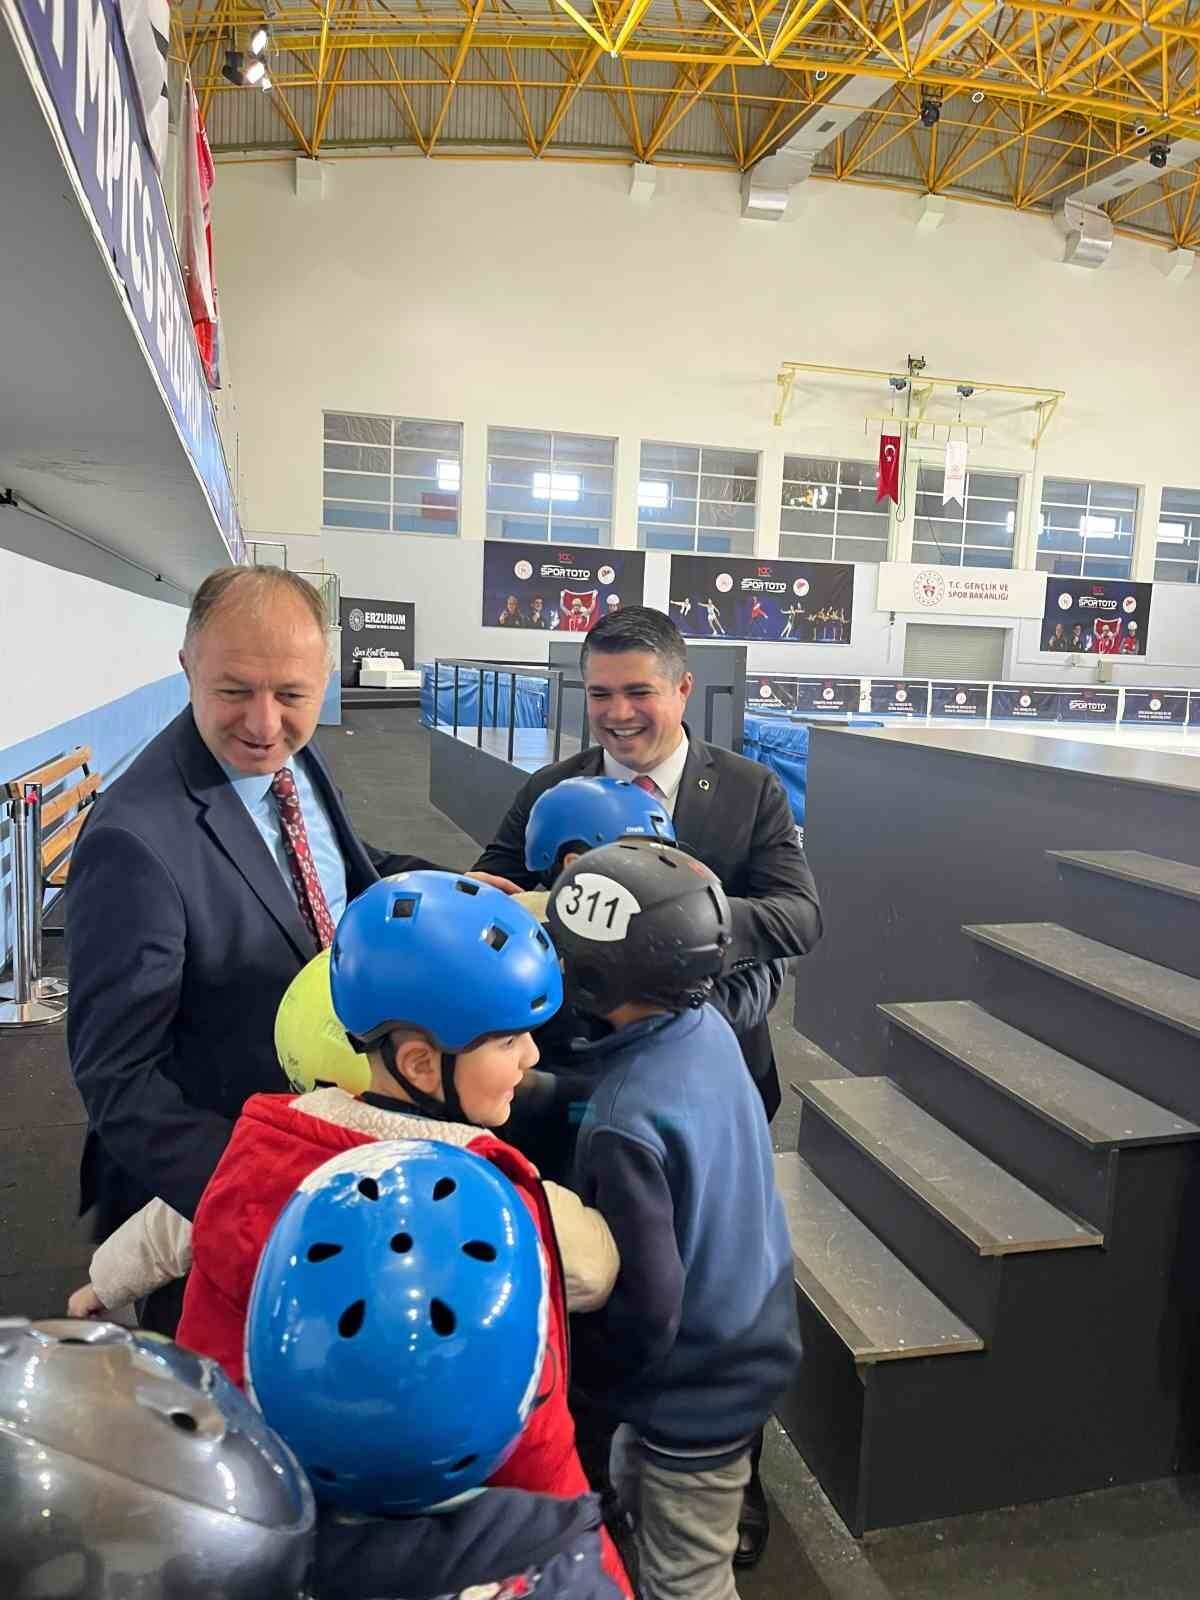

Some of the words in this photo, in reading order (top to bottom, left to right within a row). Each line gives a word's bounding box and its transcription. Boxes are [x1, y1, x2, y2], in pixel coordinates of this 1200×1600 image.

[40, 0, 153, 323] MPICS
[365, 612, 406, 625] ERZURUM
[565, 884, 620, 929] 311
